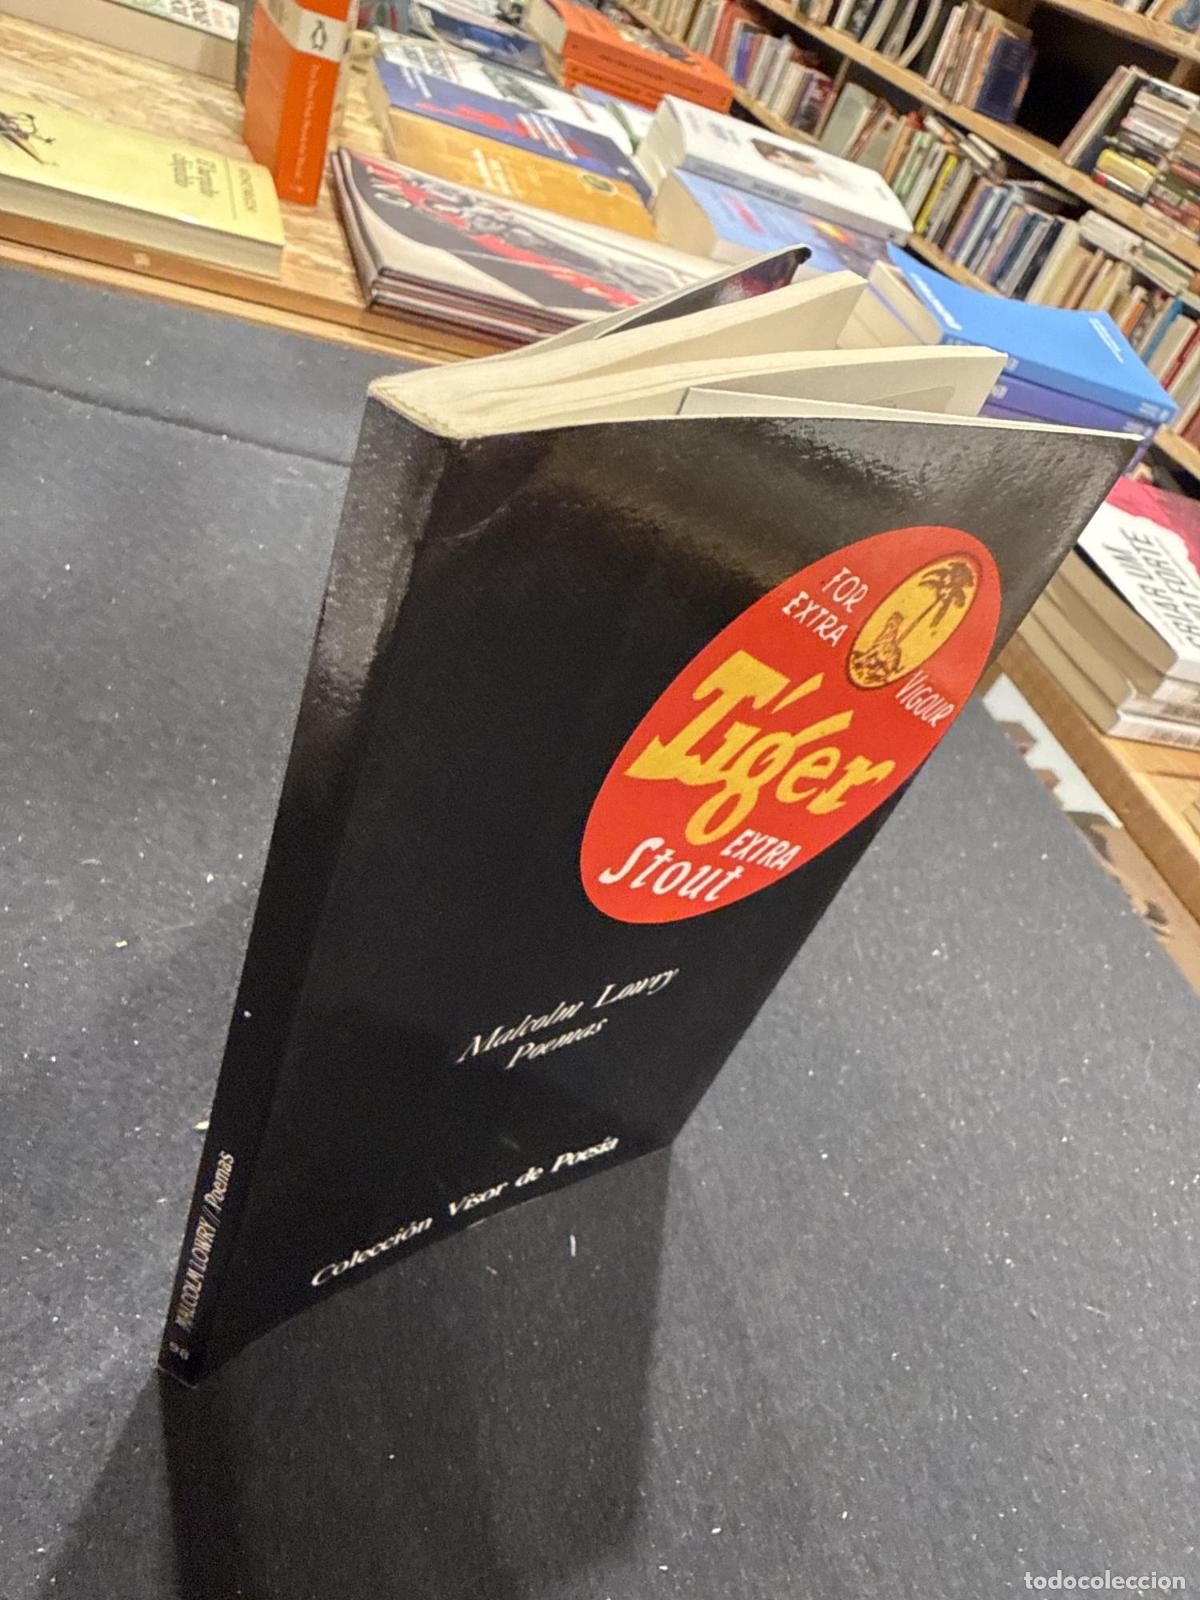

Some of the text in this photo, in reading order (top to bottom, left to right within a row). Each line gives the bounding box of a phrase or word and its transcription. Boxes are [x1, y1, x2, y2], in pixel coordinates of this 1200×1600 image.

[782, 591, 849, 648] EXTRA
[821, 566, 869, 613] FOR
[894, 669, 955, 728] VIGOUR
[624, 649, 897, 846] Tiger
[598, 837, 745, 902] Stout
[720, 829, 802, 872] EXTRA
[456, 967, 680, 1064] Malcolm Lowry
[504, 1017, 609, 1070] Poemas
[204, 1150, 235, 1212] Poemas
[311, 1135, 620, 1287] Colección Visor de Poesía
[188, 1215, 217, 1273] LOWRY
[175, 1267, 205, 1332] MALCOLM
